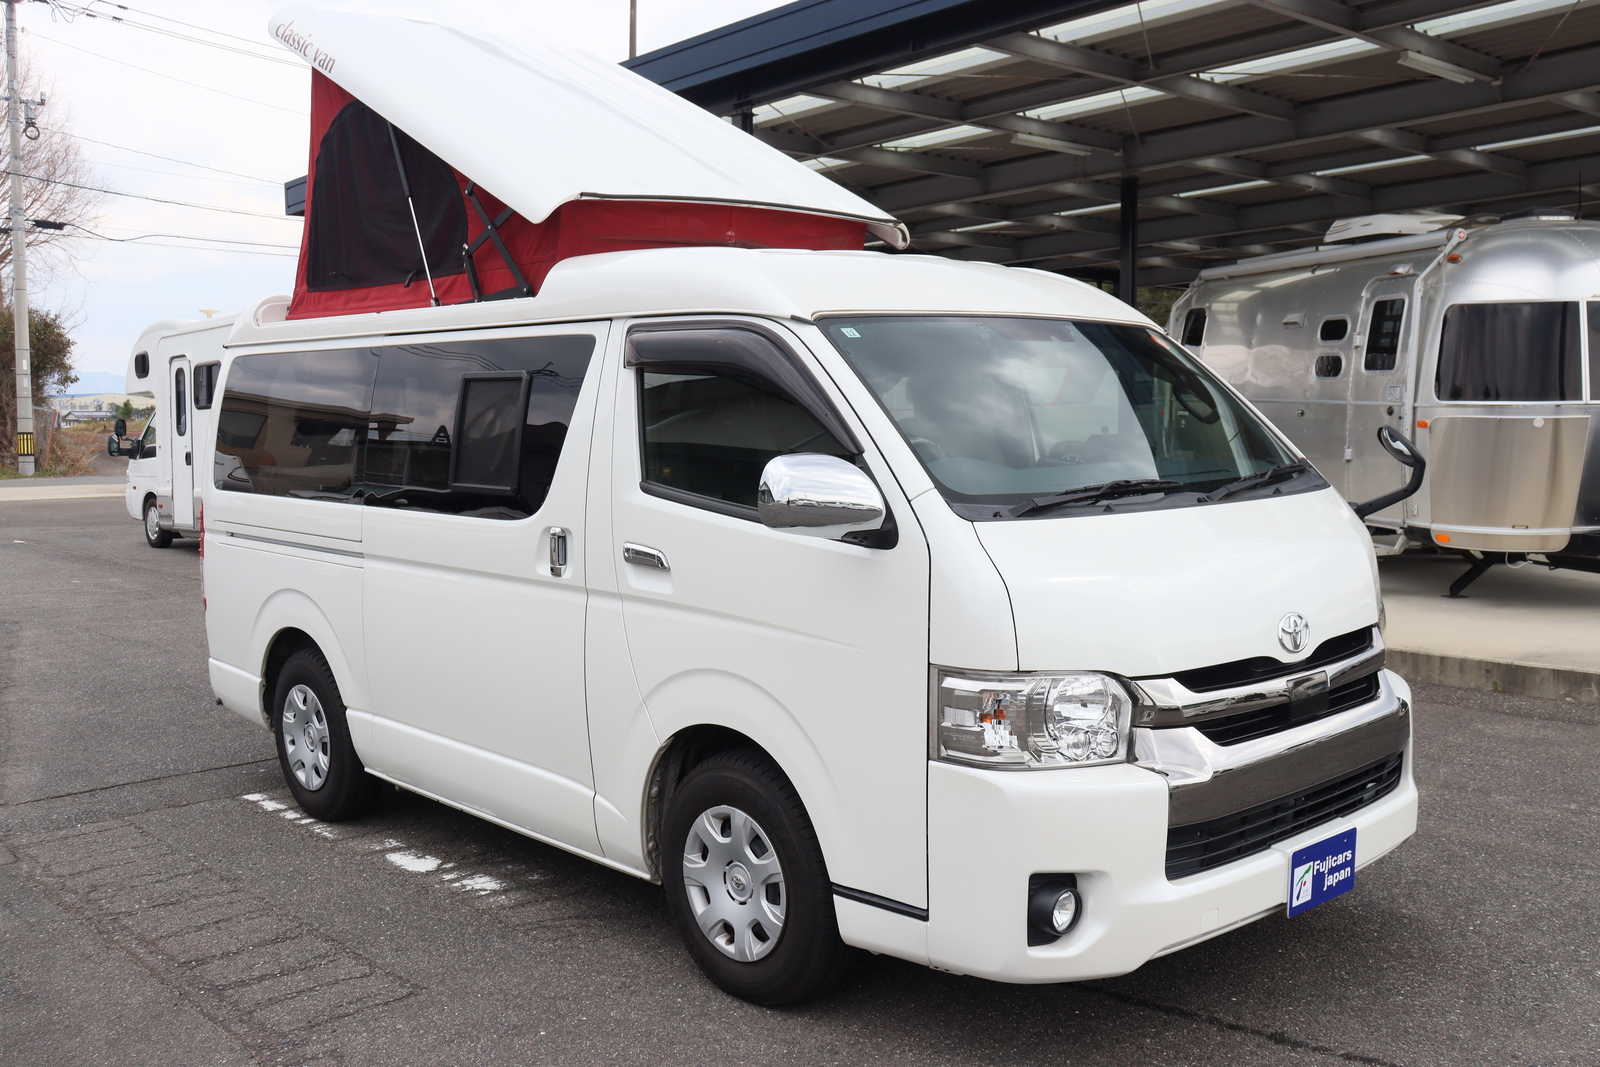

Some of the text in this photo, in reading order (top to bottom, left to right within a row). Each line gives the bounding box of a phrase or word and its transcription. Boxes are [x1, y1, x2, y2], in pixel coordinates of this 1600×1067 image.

[275, 20, 336, 74] classic van
[1313, 850, 1352, 876] Fujicars
[1323, 866, 1351, 891] japan
